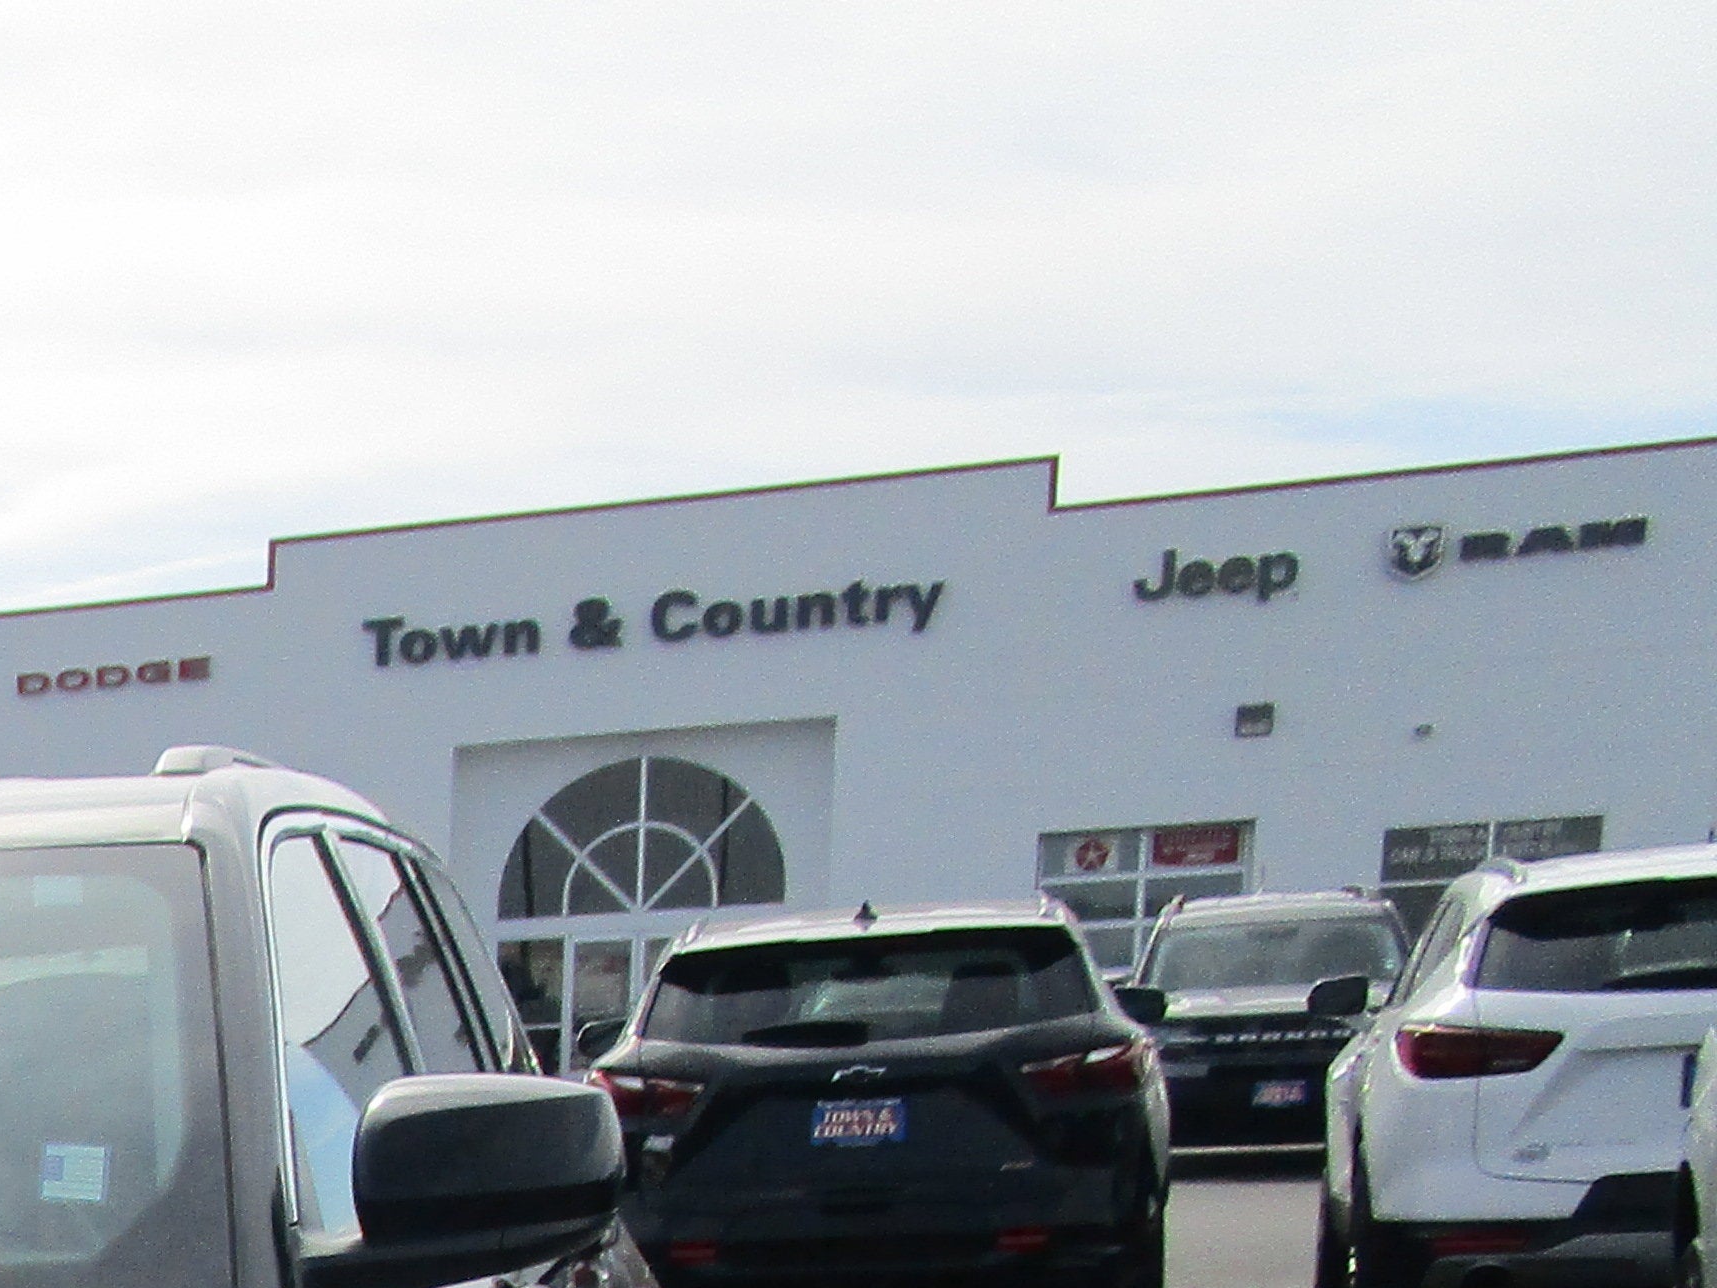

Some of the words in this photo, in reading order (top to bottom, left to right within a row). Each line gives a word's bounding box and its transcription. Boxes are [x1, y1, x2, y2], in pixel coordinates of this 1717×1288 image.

[1460, 516, 1650, 561] RAM
[1133, 547, 1301, 602] Jeep
[362, 615, 541, 667] Town
[568, 596, 623, 649] &
[651, 577, 946, 643] Country
[16, 655, 212, 696] DODGE
